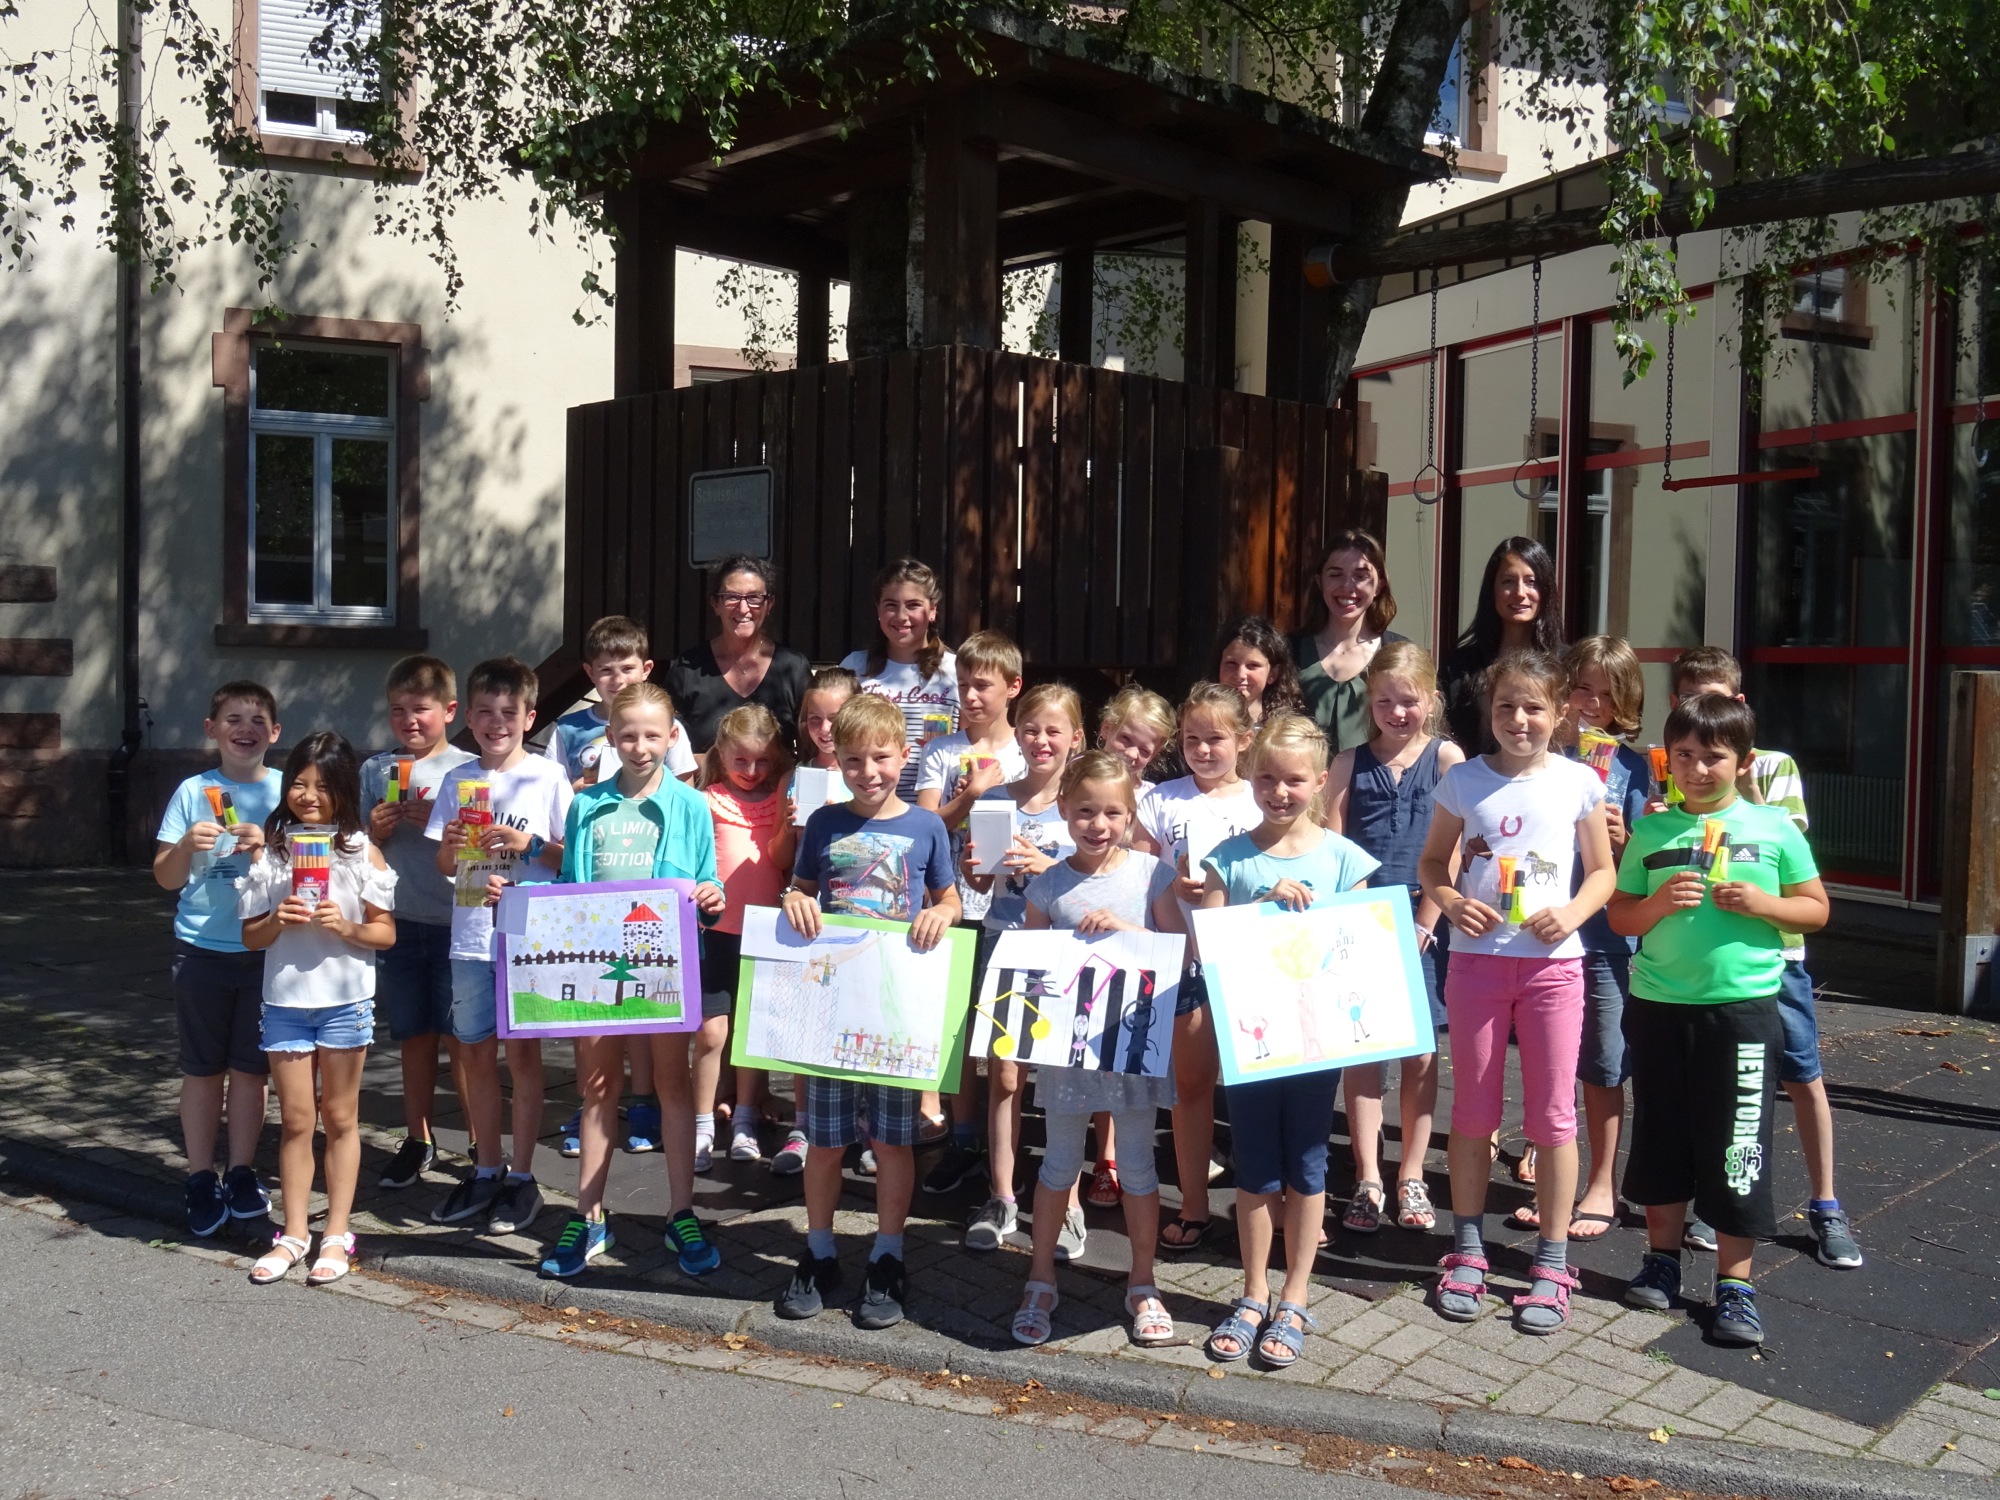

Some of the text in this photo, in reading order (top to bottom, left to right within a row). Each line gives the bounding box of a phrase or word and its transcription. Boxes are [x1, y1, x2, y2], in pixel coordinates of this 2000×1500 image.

[907, 686, 950, 704] Cool
[494, 811, 529, 832] ING
[1733, 1043, 1765, 1148] NEW YORK
[1725, 1144, 1762, 1174] 86
